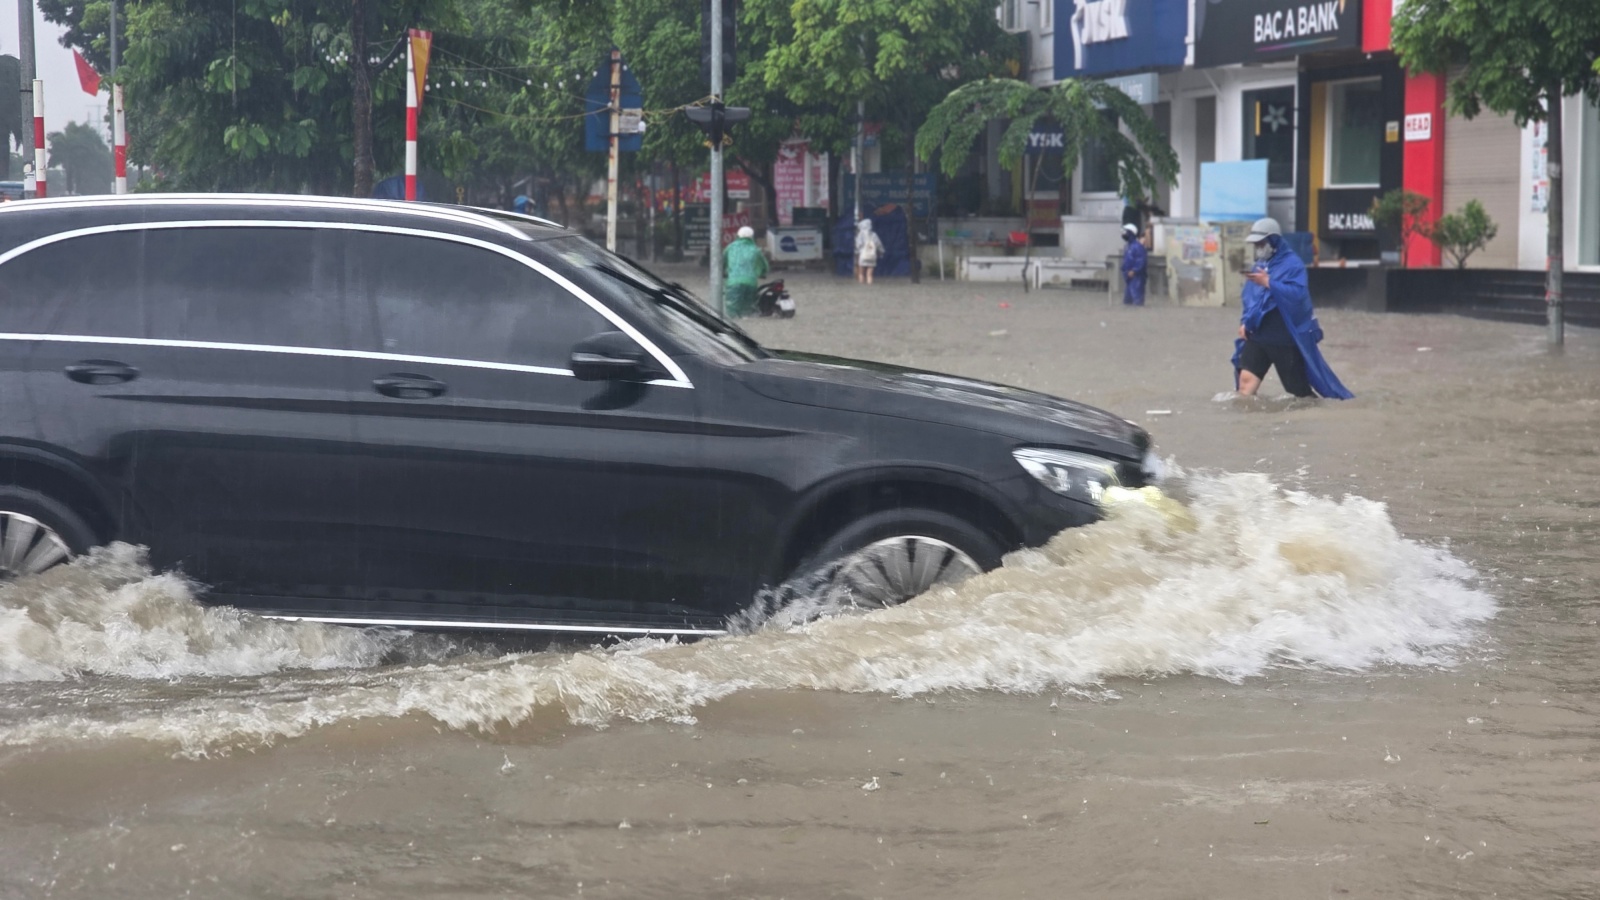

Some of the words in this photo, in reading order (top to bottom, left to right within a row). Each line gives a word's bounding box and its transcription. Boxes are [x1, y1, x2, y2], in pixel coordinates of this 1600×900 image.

[1254, 10, 1283, 43] BAC
[1283, 8, 1296, 39] A
[1297, 0, 1340, 37] BANK
[1406, 117, 1429, 132] HEAD
[1025, 133, 1064, 147] YSK
[1328, 213, 1345, 230] BAC
[1345, 213, 1352, 230] A
